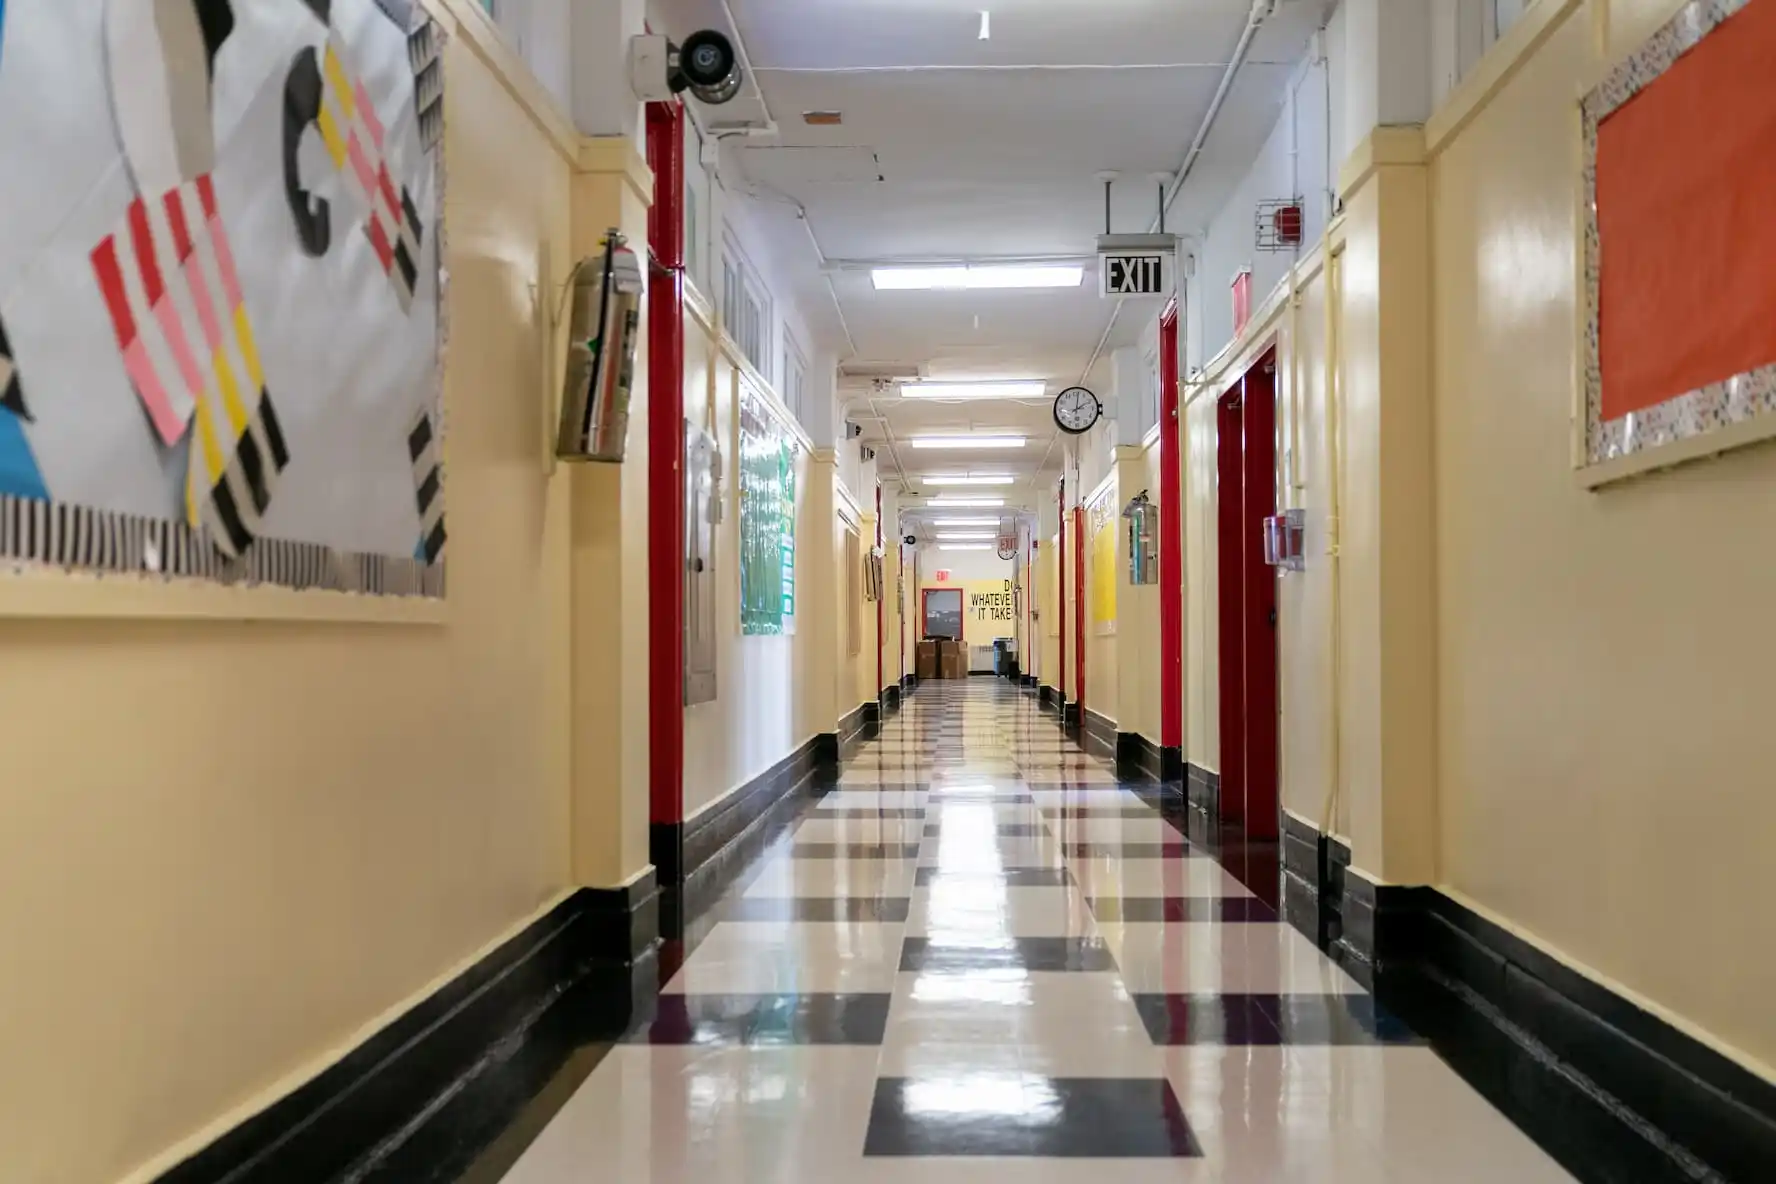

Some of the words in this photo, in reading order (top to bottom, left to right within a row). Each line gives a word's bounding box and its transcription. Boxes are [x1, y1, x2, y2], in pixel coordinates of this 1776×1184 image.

[1106, 257, 1159, 292] EXIT
[1000, 538, 1018, 550] EXIT
[1004, 579, 1013, 592] D
[971, 593, 1013, 606] WHATEVE
[978, 607, 986, 621] IT
